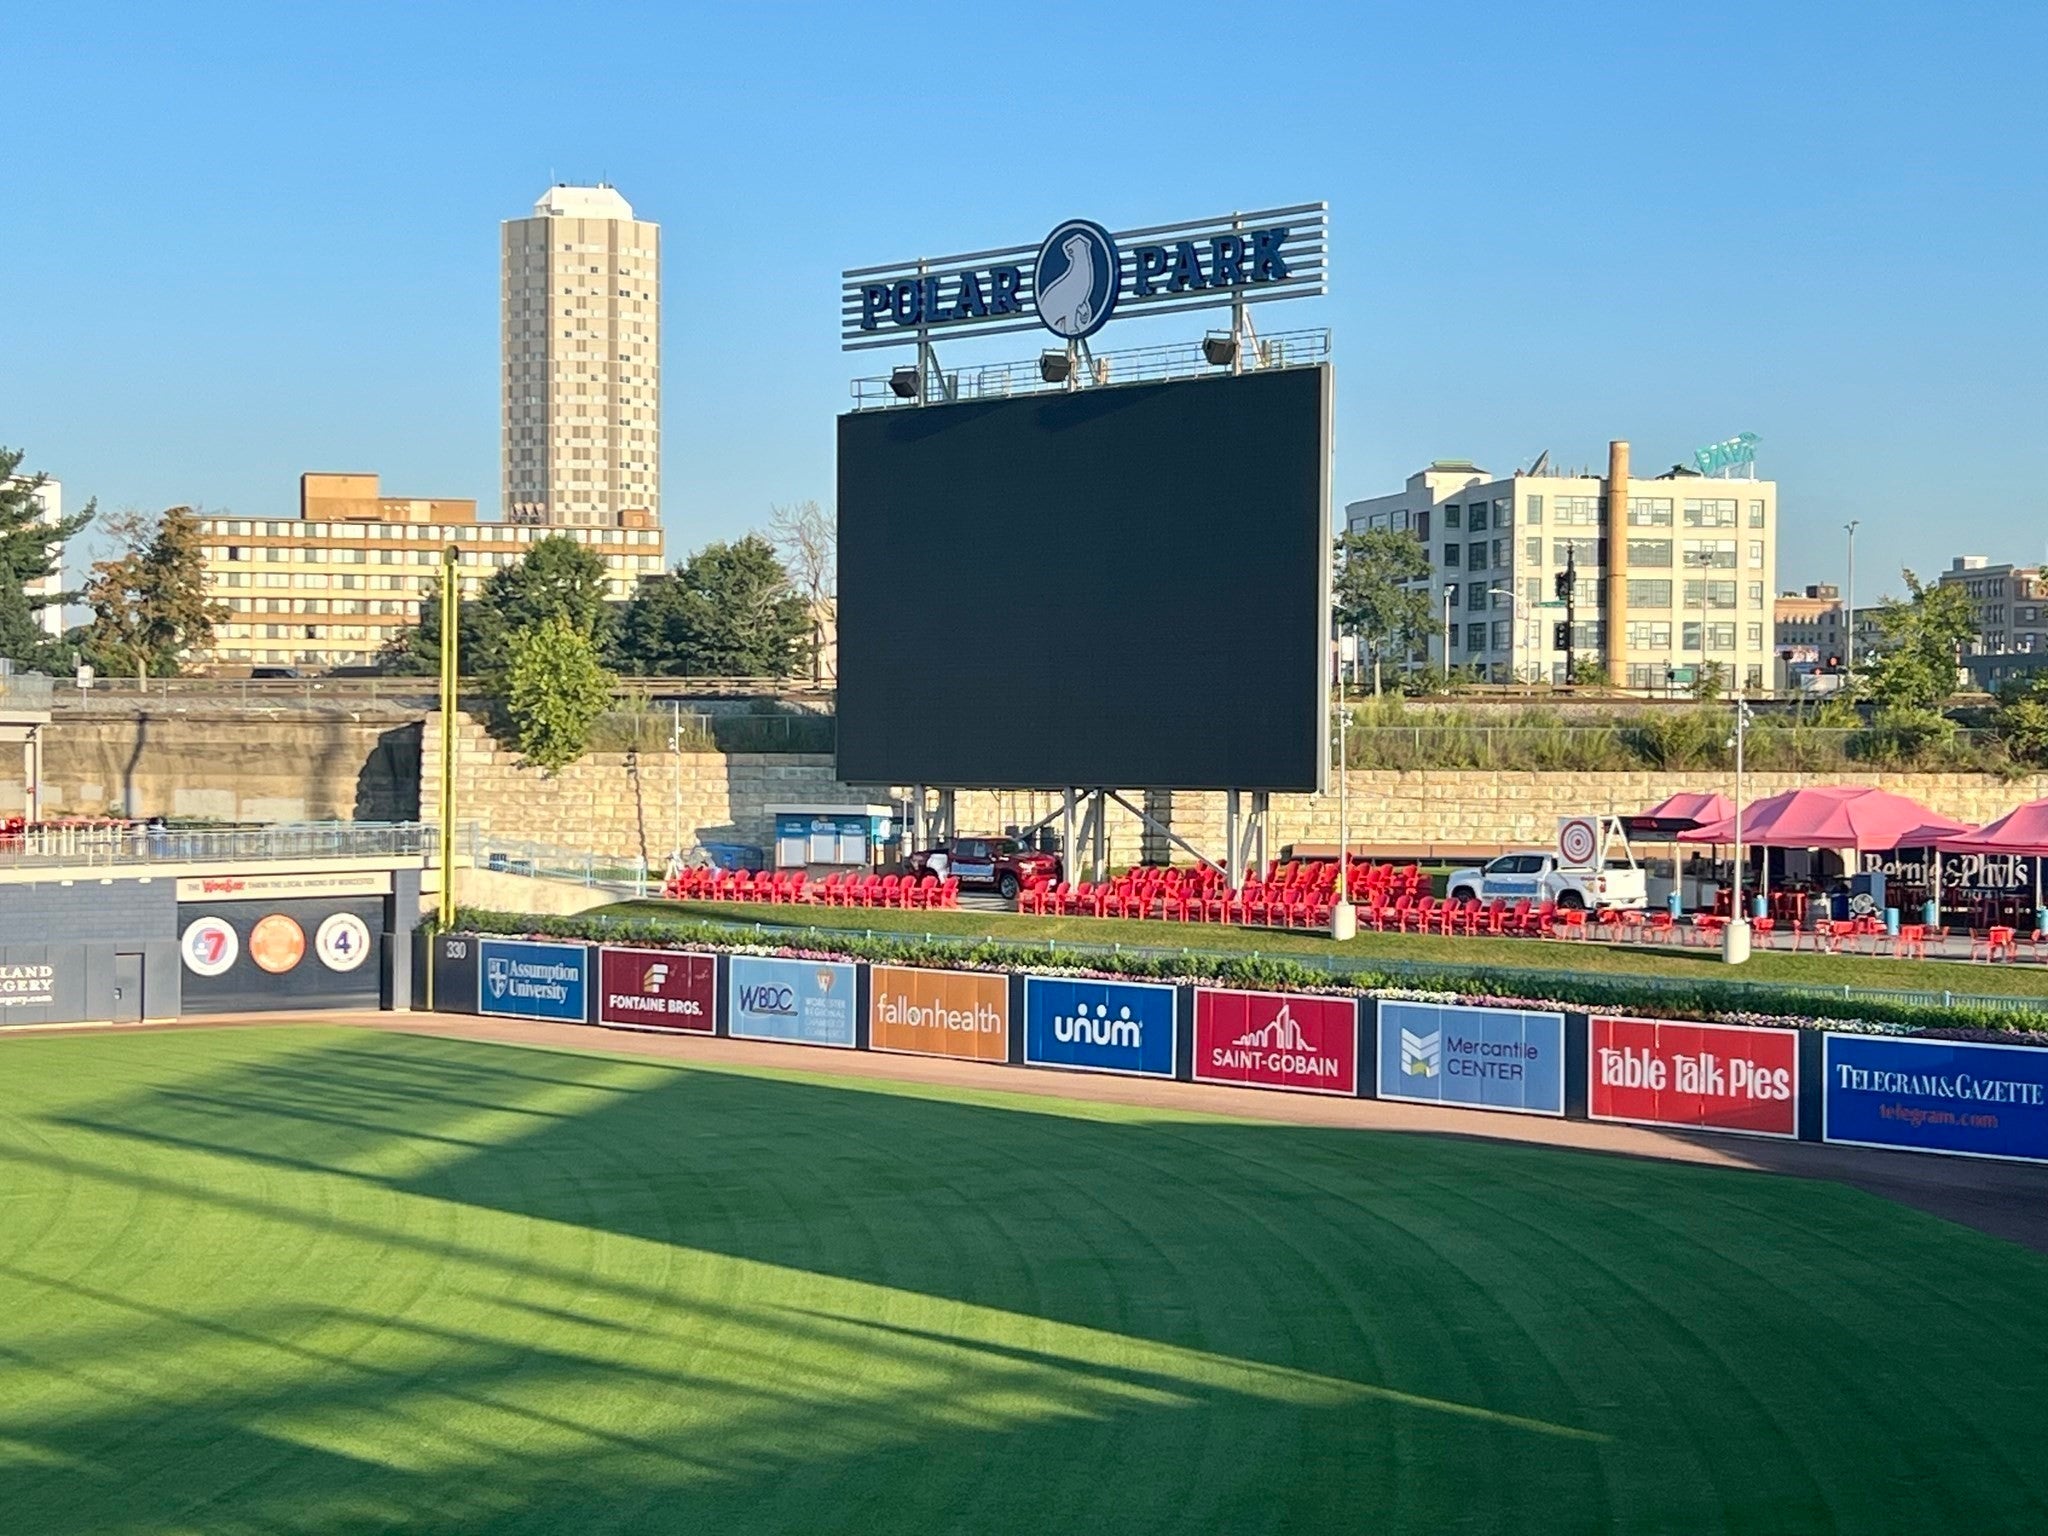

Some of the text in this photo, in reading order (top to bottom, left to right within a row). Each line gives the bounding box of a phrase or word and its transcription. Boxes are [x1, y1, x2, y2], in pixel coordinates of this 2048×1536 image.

[860, 227, 1291, 330] POLAR PARK
[204, 930, 226, 962] 7
[334, 930, 352, 955] 4
[446, 940, 467, 959] 330
[509, 959, 579, 982] Assumption
[509, 978, 569, 1004] University
[739, 984, 794, 1012] WBDC
[609, 994, 704, 1016] FONTAINE BROS.
[877, 993, 1001, 1034] fallonhealth
[1447, 1037, 1538, 1060] Mercantile
[1212, 1048, 1338, 1077] SAINT-GOBAIN
[1447, 1059, 1523, 1081] CENTER
[1598, 1047, 1790, 1100] Table Talk Pies
[1879, 1103, 1999, 1128] telegram.com
